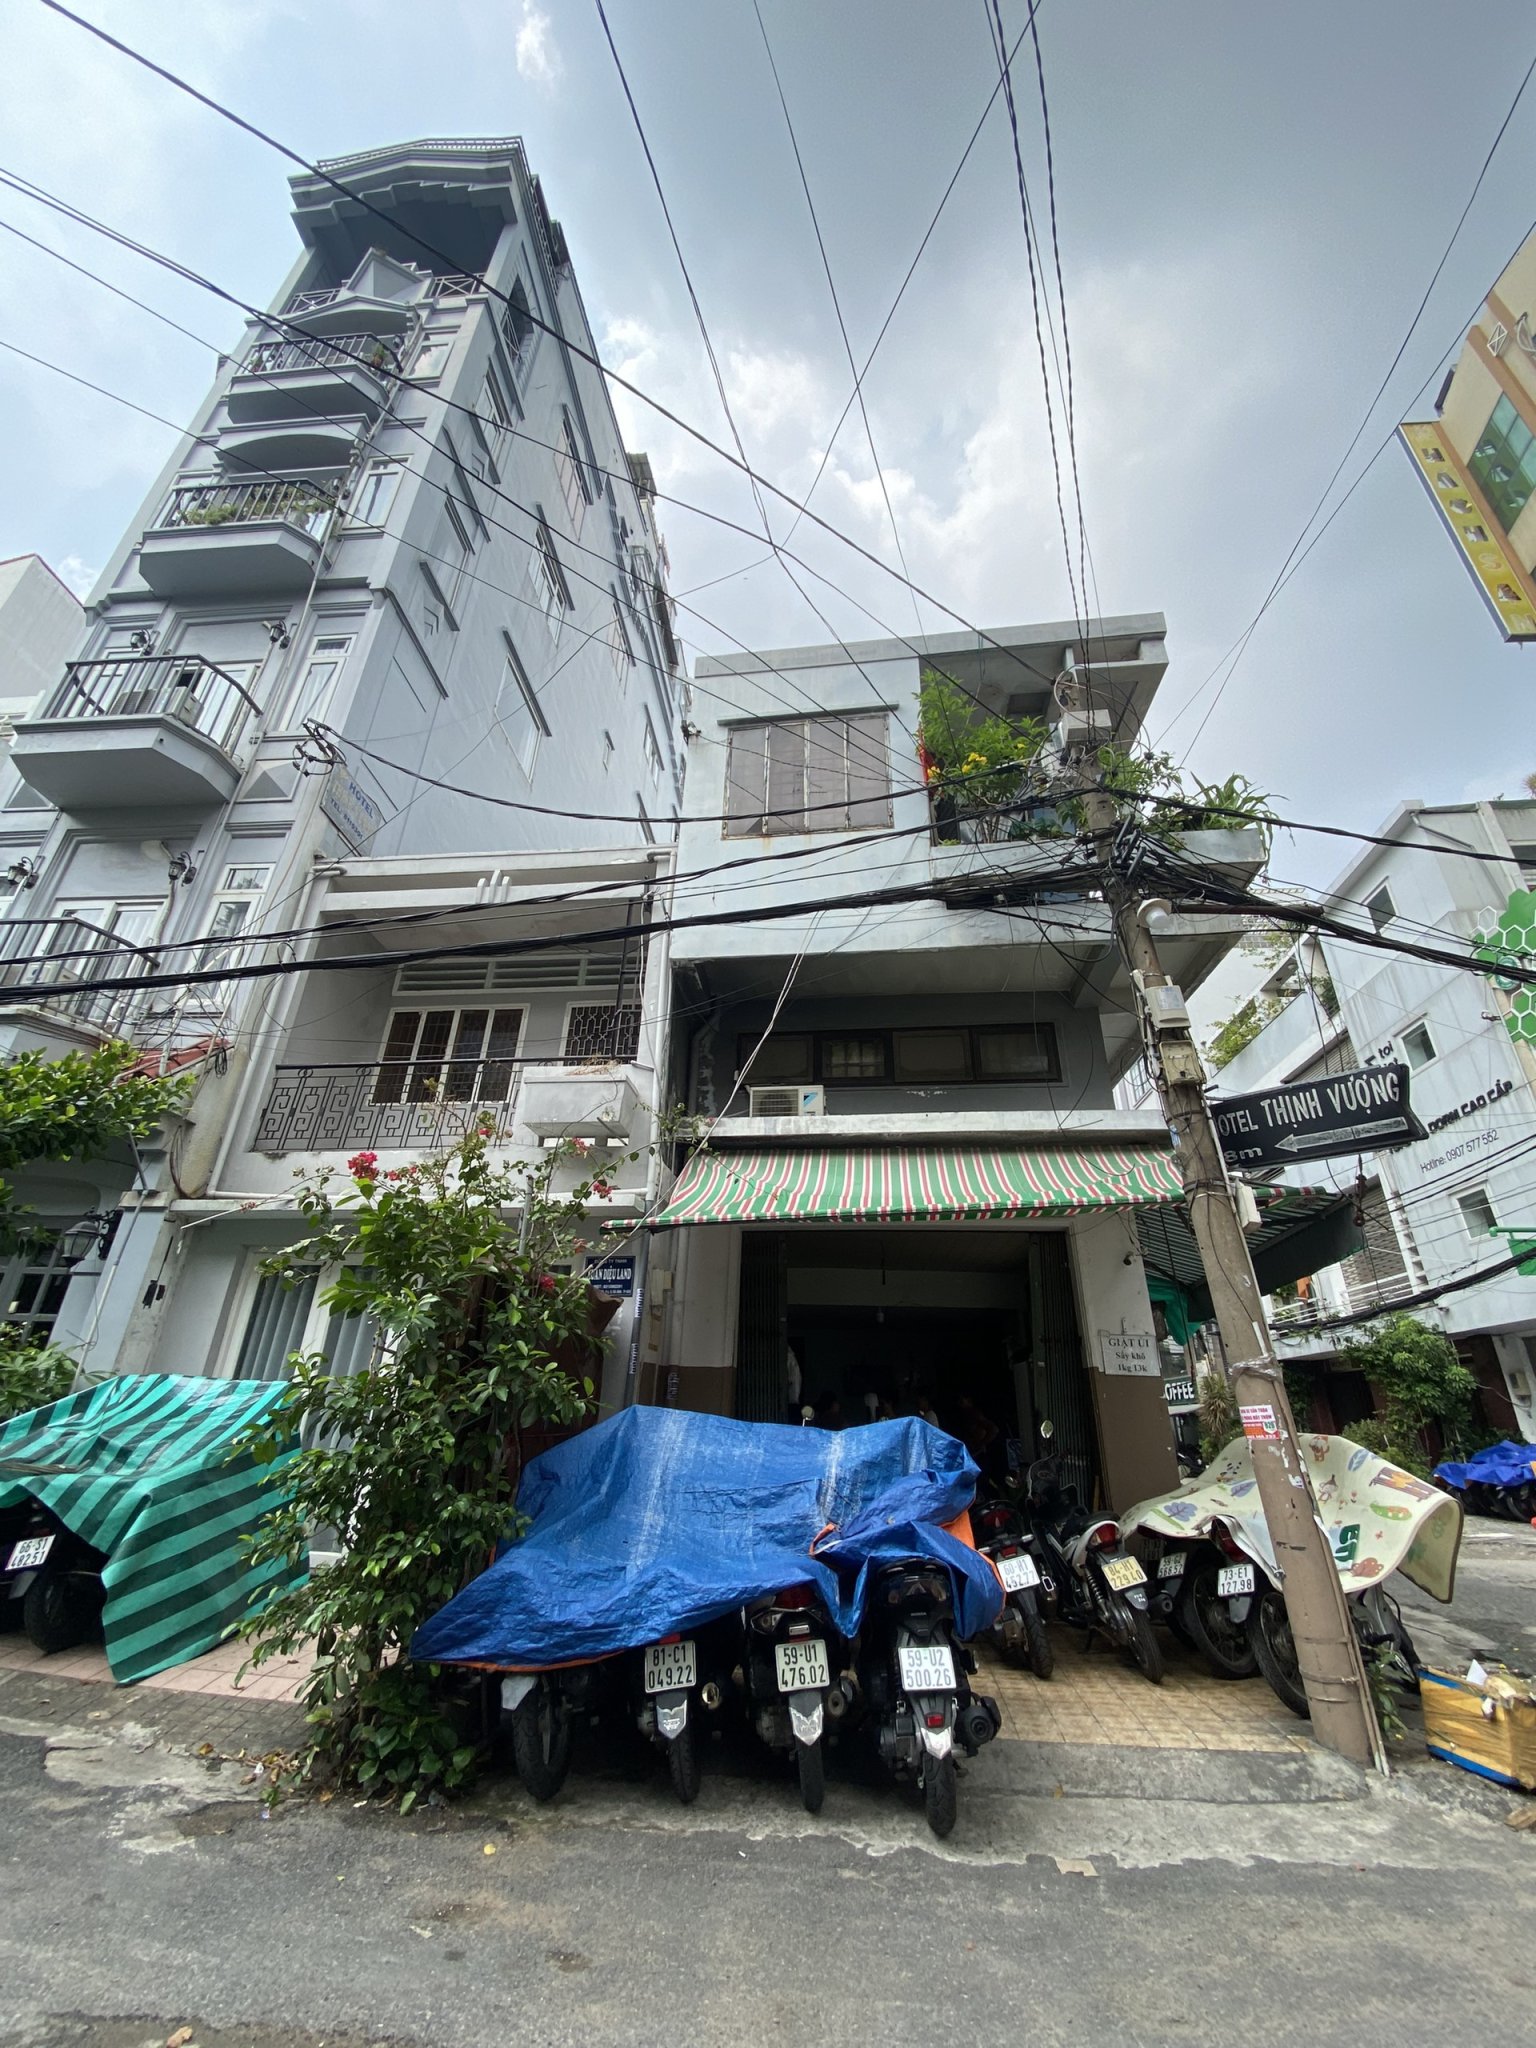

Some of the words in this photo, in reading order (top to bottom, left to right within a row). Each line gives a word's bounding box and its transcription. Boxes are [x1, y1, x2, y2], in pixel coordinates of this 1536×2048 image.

[349, 782, 373, 819] HOTEL
[1260, 1088, 1323, 1128] THỊNH
[1327, 1071, 1400, 1115] VƯỢNG
[1427, 1108, 1460, 1134] DORM
[1460, 1094, 1488, 1117] CAO
[1487, 1079, 1512, 1103] CẤP
[1445, 1144, 1465, 1162] 0907
[1466, 1135, 1481, 1153] 577
[1481, 1129, 1499, 1145] 552
[617, 1268, 632, 1280] LAND
[1164, 1381, 1195, 1401] OFFEE
[1223, 1566, 1248, 1582] 73-E1
[1221, 1578, 1252, 1594] 127.98
[653, 1644, 687, 1667] 81-C1
[783, 1644, 818, 1666] 59-U1
[907, 1649, 945, 1668] 59-U2
[648, 1664, 693, 1689] 049.22
[781, 1663, 826, 1688] 476.02
[906, 1668, 952, 1688] 500.26
